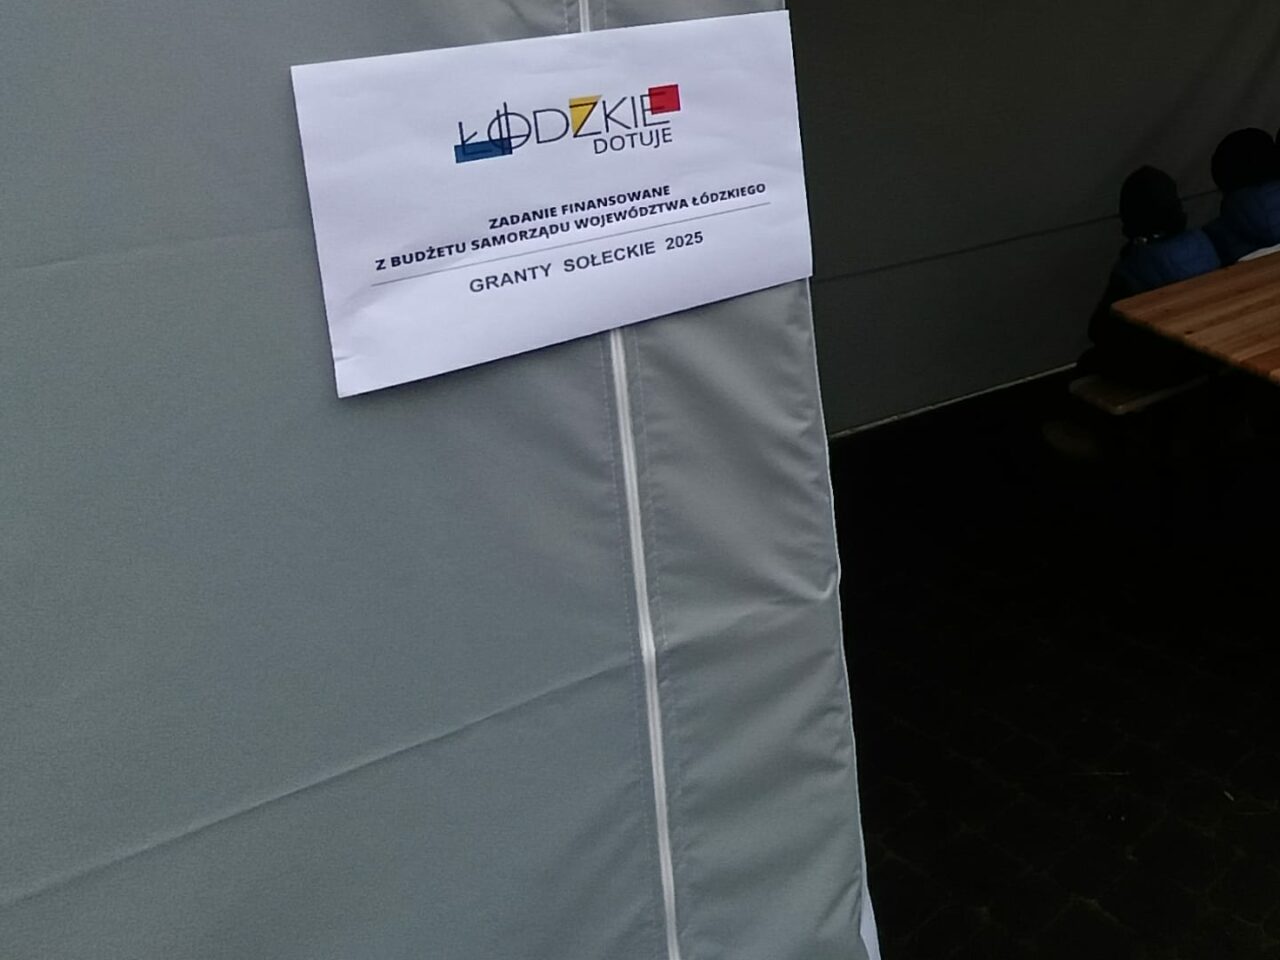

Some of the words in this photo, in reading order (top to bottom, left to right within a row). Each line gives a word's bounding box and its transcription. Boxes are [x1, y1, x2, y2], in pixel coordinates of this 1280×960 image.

[593, 127, 673, 154] DOTUJE
[375, 258, 387, 271] Z
[390, 242, 466, 268] BUDŻETU
[471, 221, 571, 251] SAMORZĄDU
[574, 198, 689, 230] WOJEWÓDZTWA
[691, 183, 767, 207] ŁÓDZKIEGO
[488, 206, 558, 230] ZADANIE
[561, 185, 671, 215] FINANSOWANE
[469, 262, 552, 293] GRANTY
[563, 240, 656, 273] SOŁECKIE
[664, 230, 704, 251] 2025
